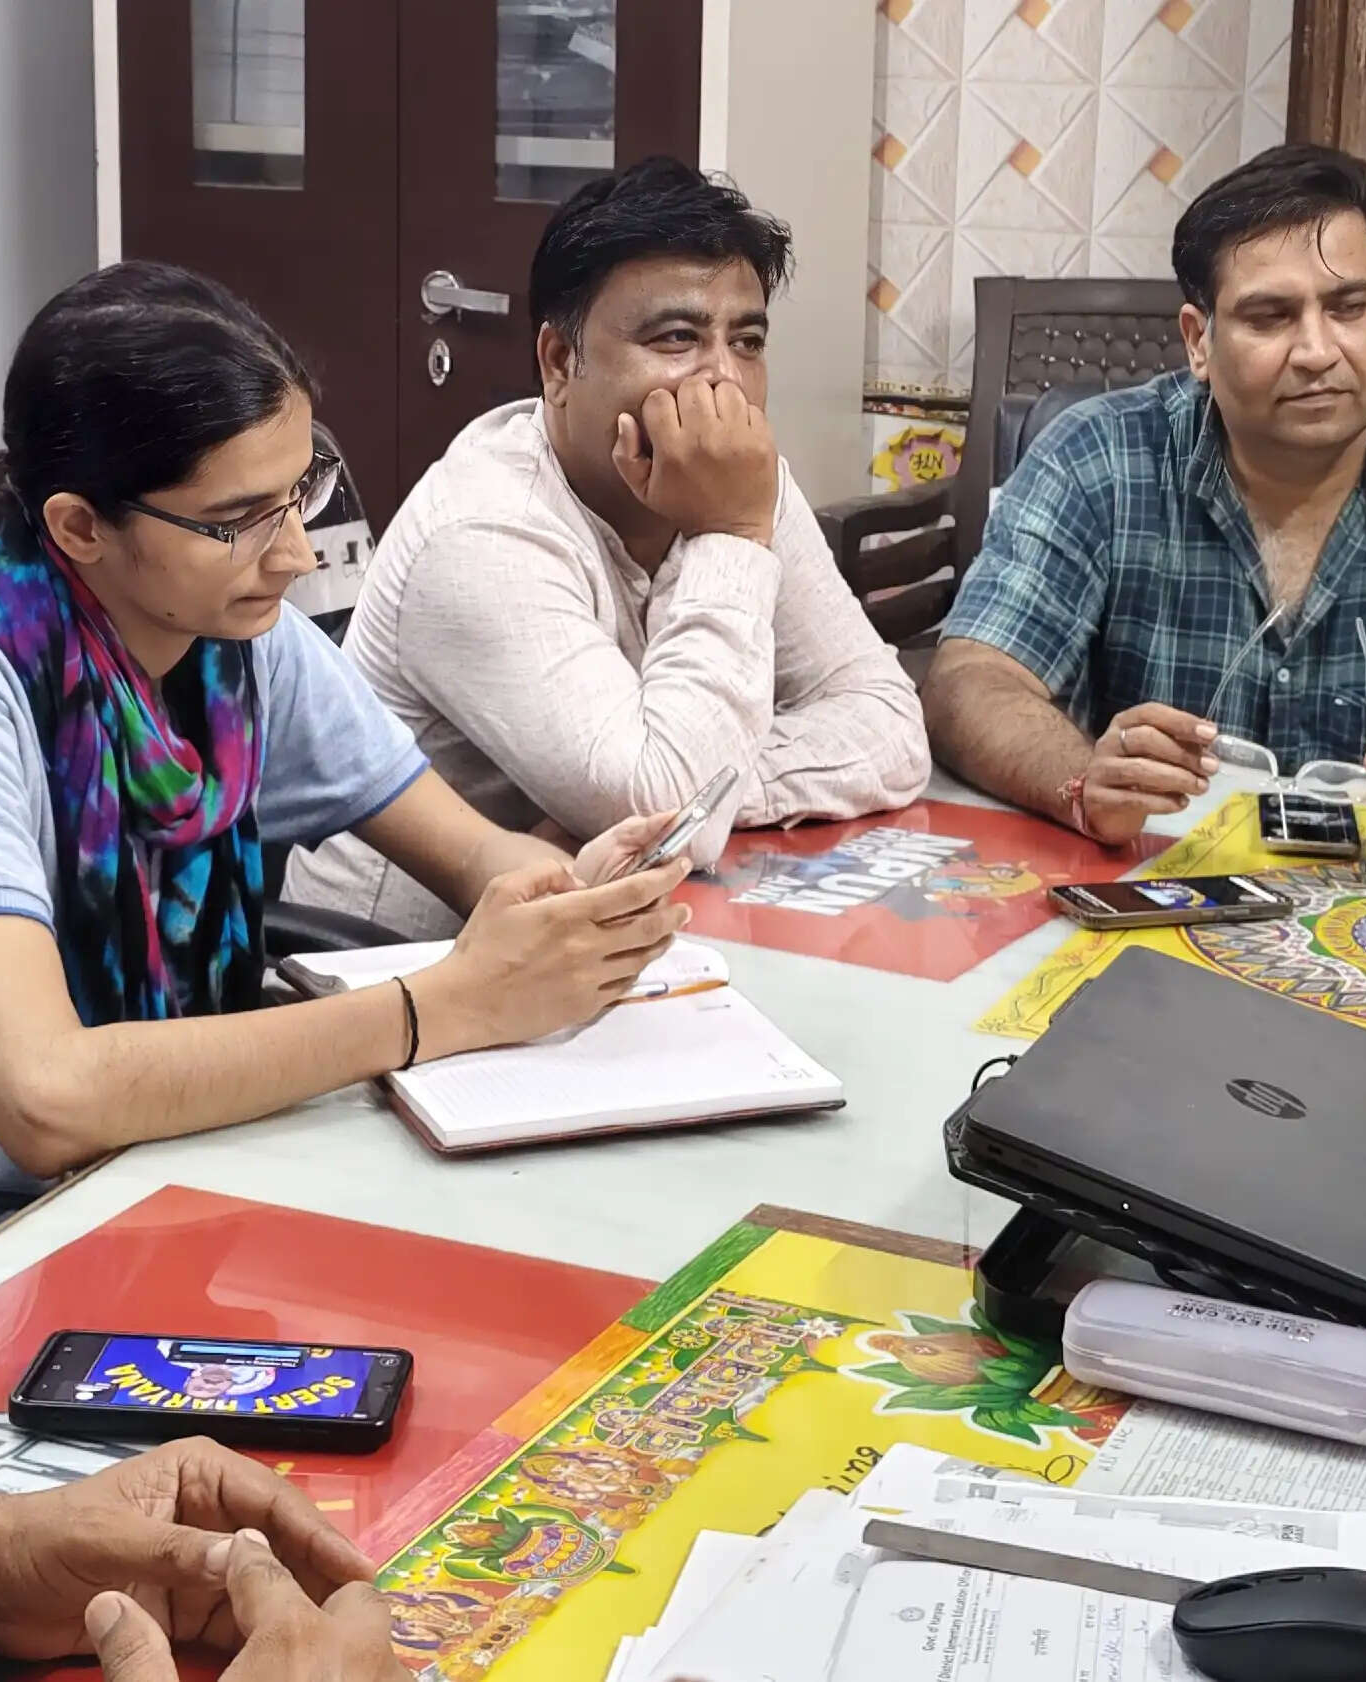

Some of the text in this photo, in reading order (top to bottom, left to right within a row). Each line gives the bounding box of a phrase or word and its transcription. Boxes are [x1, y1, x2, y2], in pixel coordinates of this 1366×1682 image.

[774, 832, 974, 916] NIPUN
[103, 1362, 356, 1414] SCERT HARYANA
[595, 1314, 807, 1456] दीपावली
